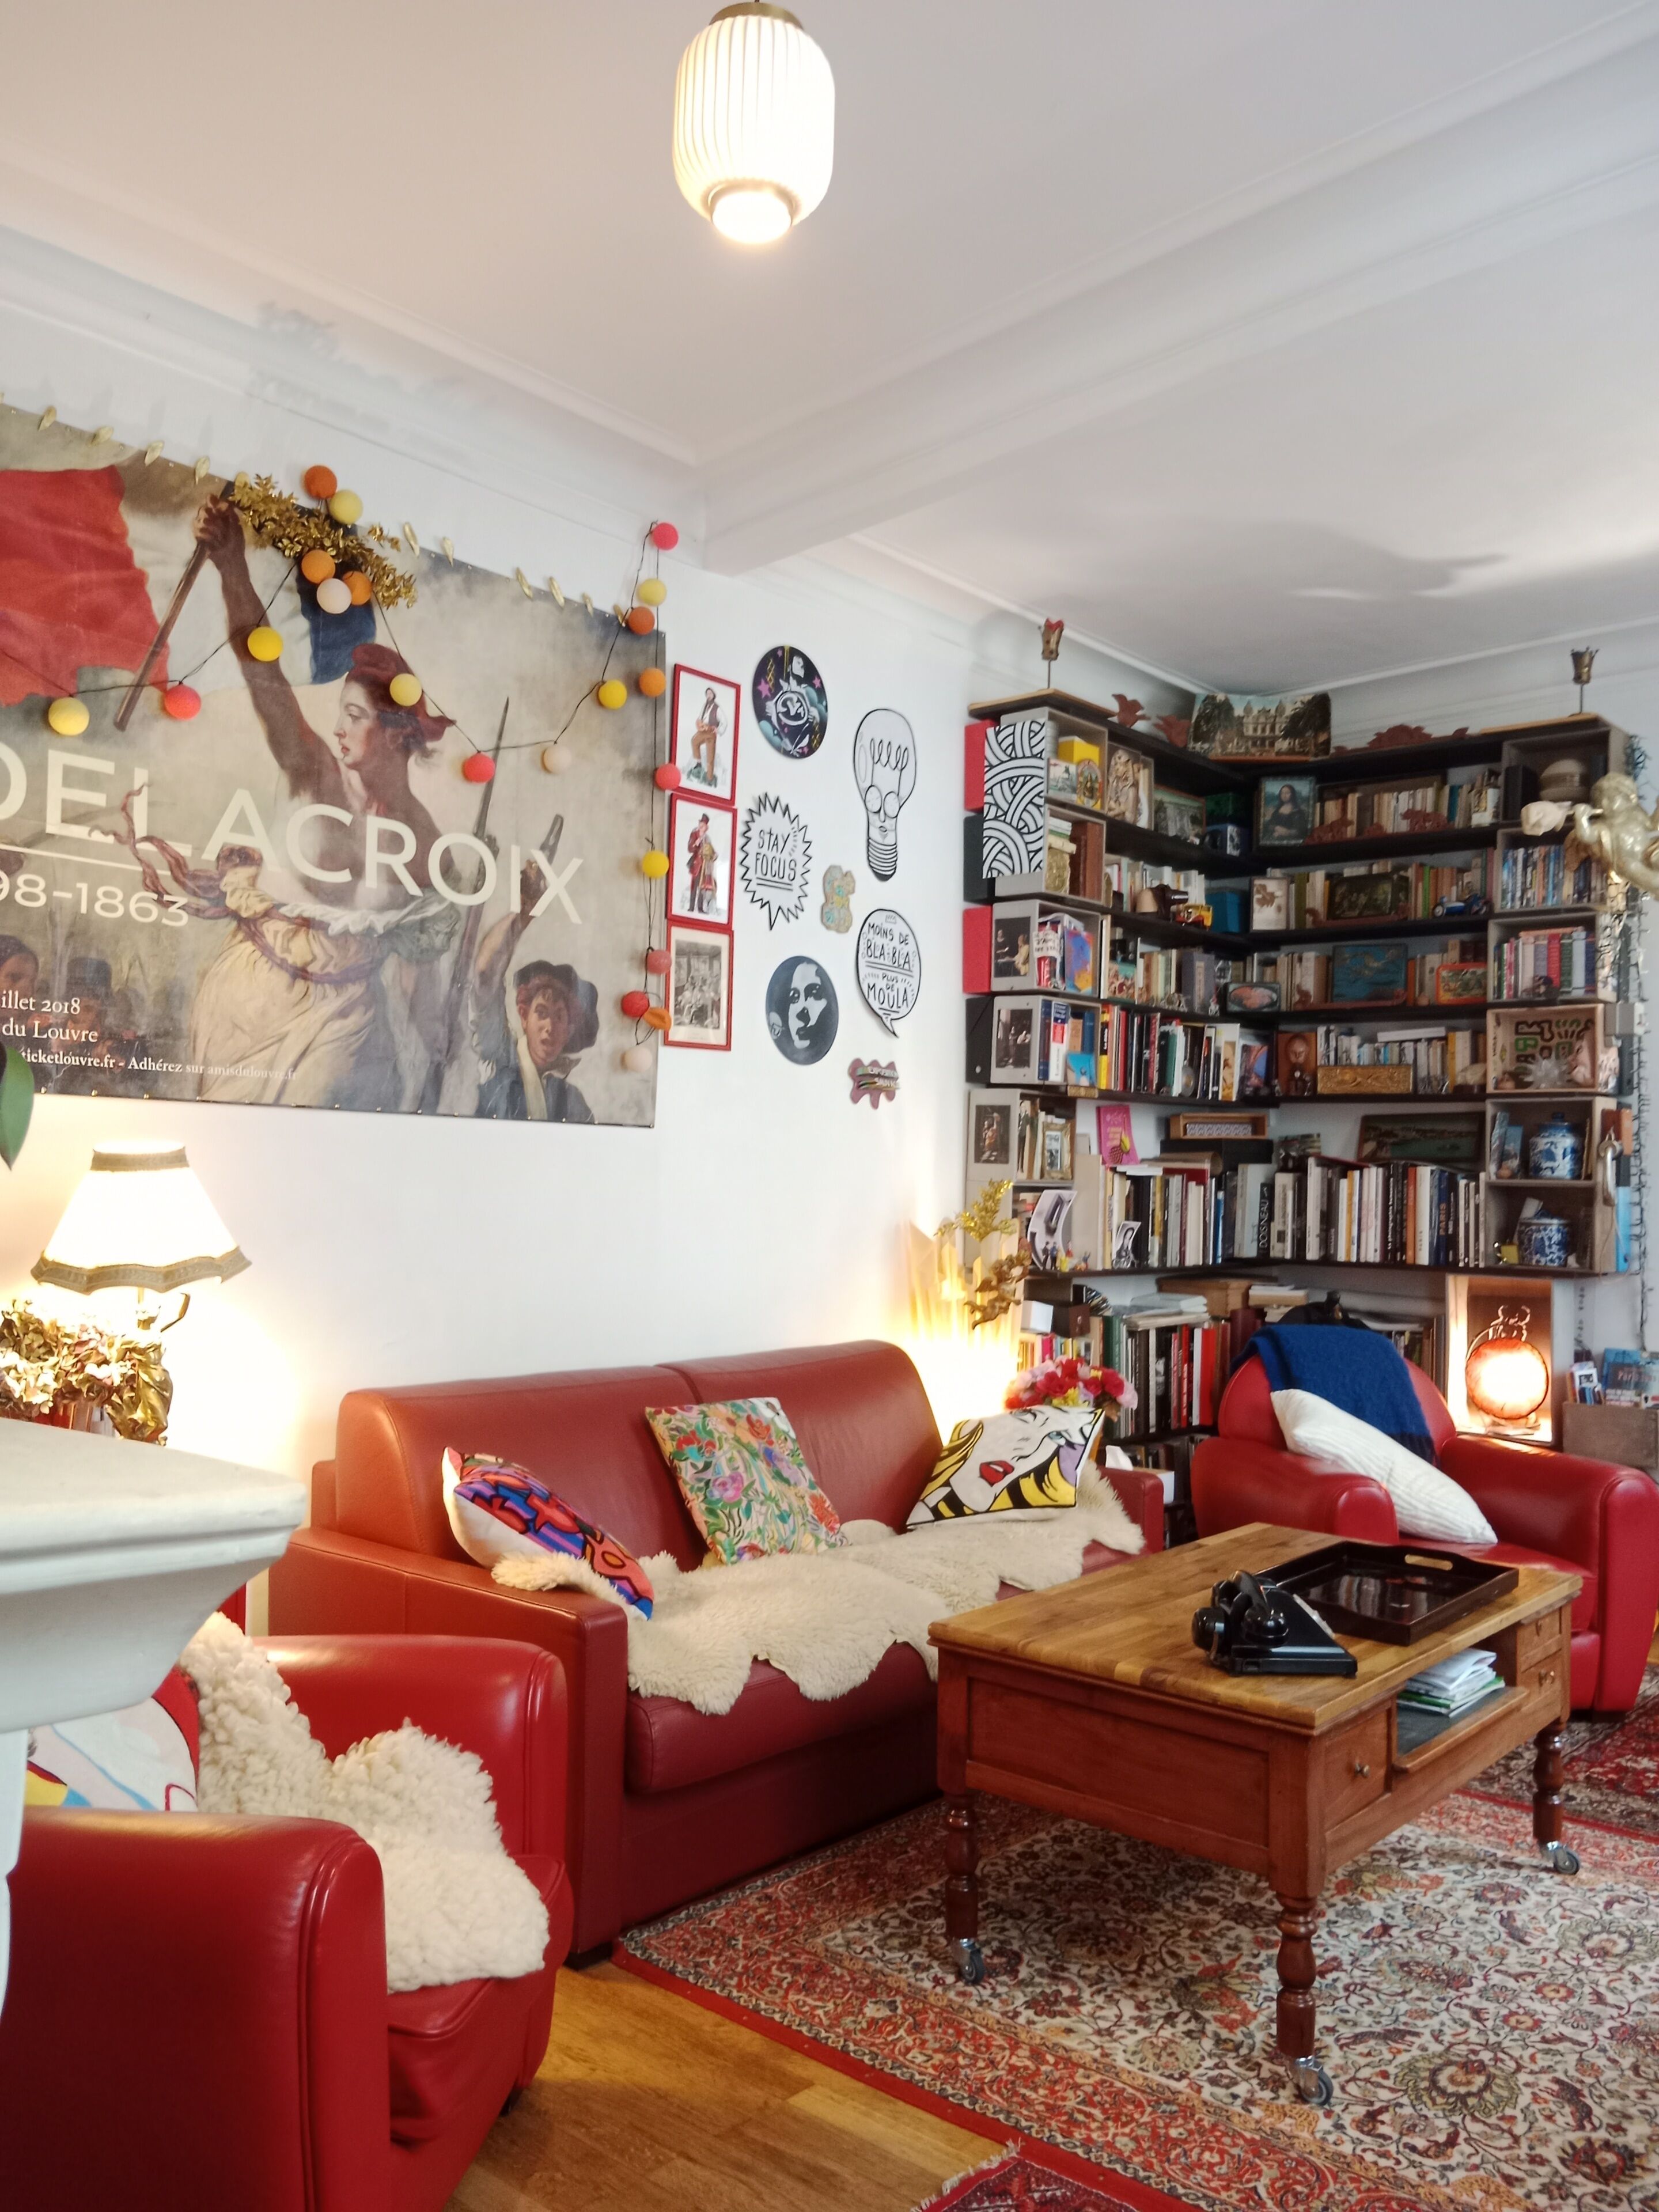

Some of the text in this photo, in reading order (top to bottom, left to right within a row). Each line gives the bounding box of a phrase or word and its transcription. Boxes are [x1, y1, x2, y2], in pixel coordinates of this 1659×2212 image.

[758, 827, 790, 854] STAY
[755, 853, 796, 881] FOCUS
[899, 932, 909, 945] DE
[882, 972, 898, 983] PLUS
[1, 990, 81, 1014] illet 2018
[867, 982, 908, 1009] MOULA
[2, 1017, 99, 1043] du Louvre
[128, 1056, 183, 1073] Adhérez
[185, 1063, 203, 1074] sur
[207, 1065, 297, 1080] amisdulouvre.fr
[1259, 1199, 1270, 1248] DOISNEAU
[1439, 1202, 1447, 1236] PARIS
